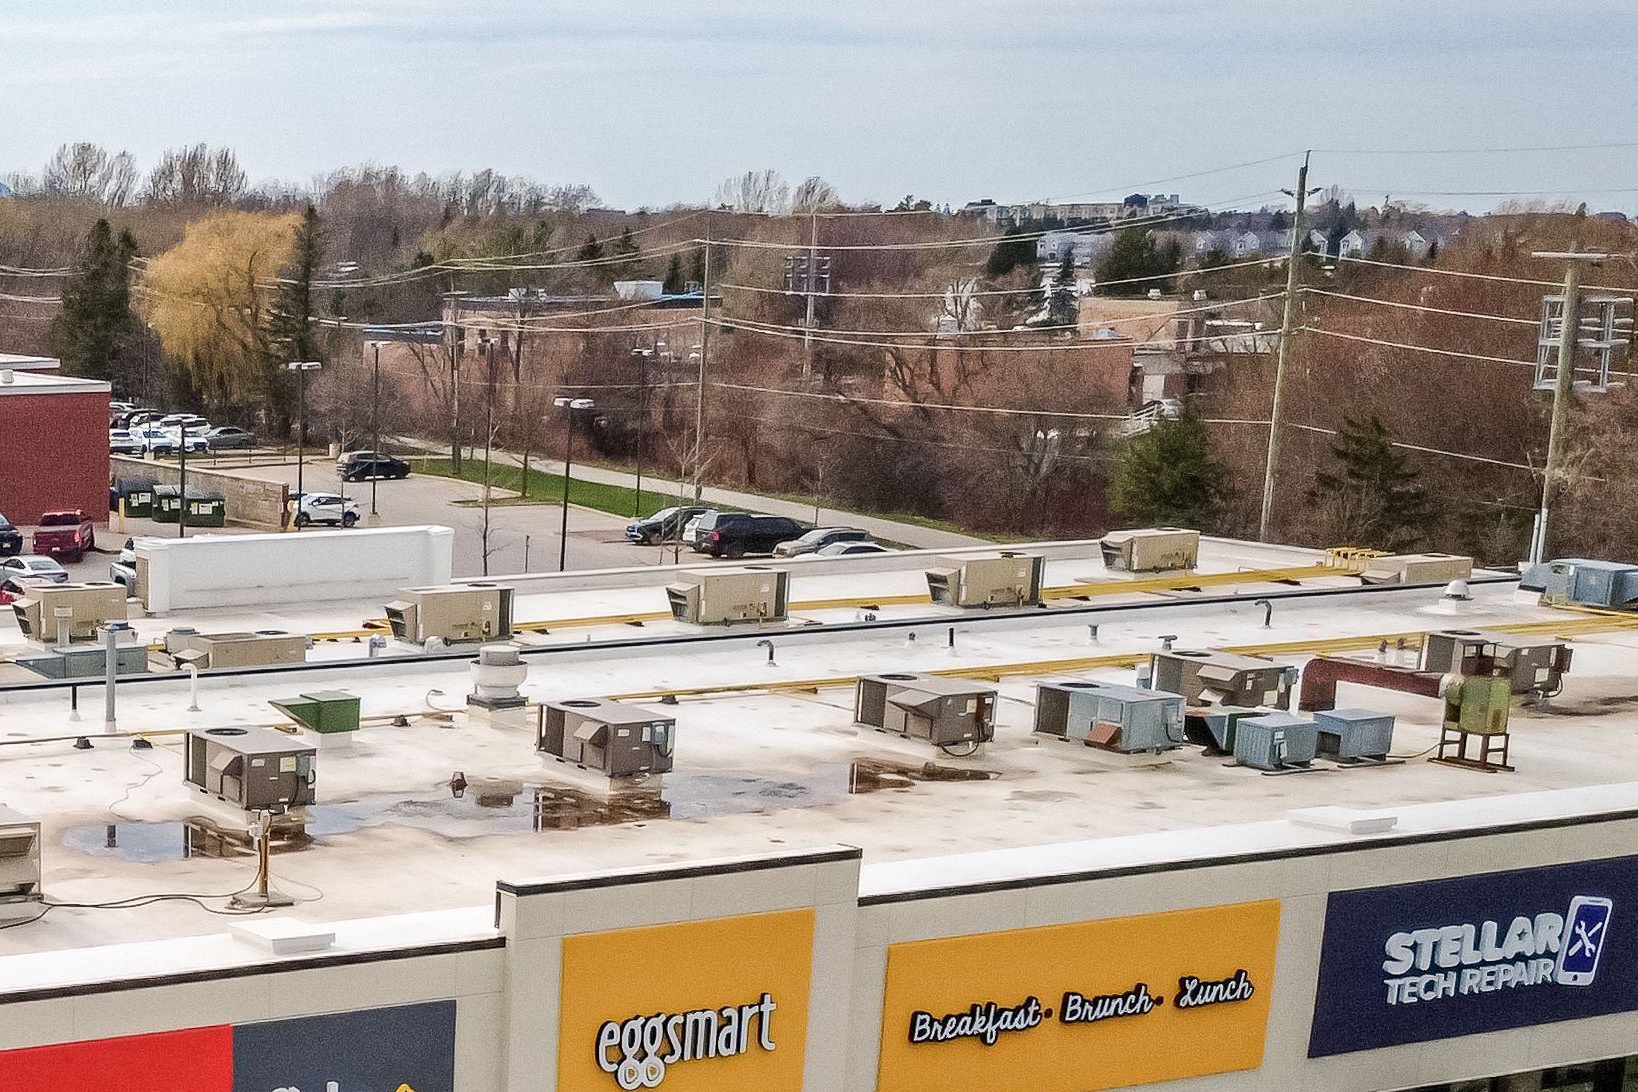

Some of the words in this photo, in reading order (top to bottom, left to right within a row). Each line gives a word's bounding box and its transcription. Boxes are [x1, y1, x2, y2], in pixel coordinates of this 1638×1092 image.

[1382, 912, 1563, 975] STELLAR
[910, 998, 1042, 1046] Breakfast
[1061, 983, 1154, 1024] Brunch
[1175, 969, 1254, 1009] Lunch
[1383, 970, 1458, 1005] TECH
[1458, 958, 1555, 996] REPAIR
[595, 992, 778, 1091] eggsmart
